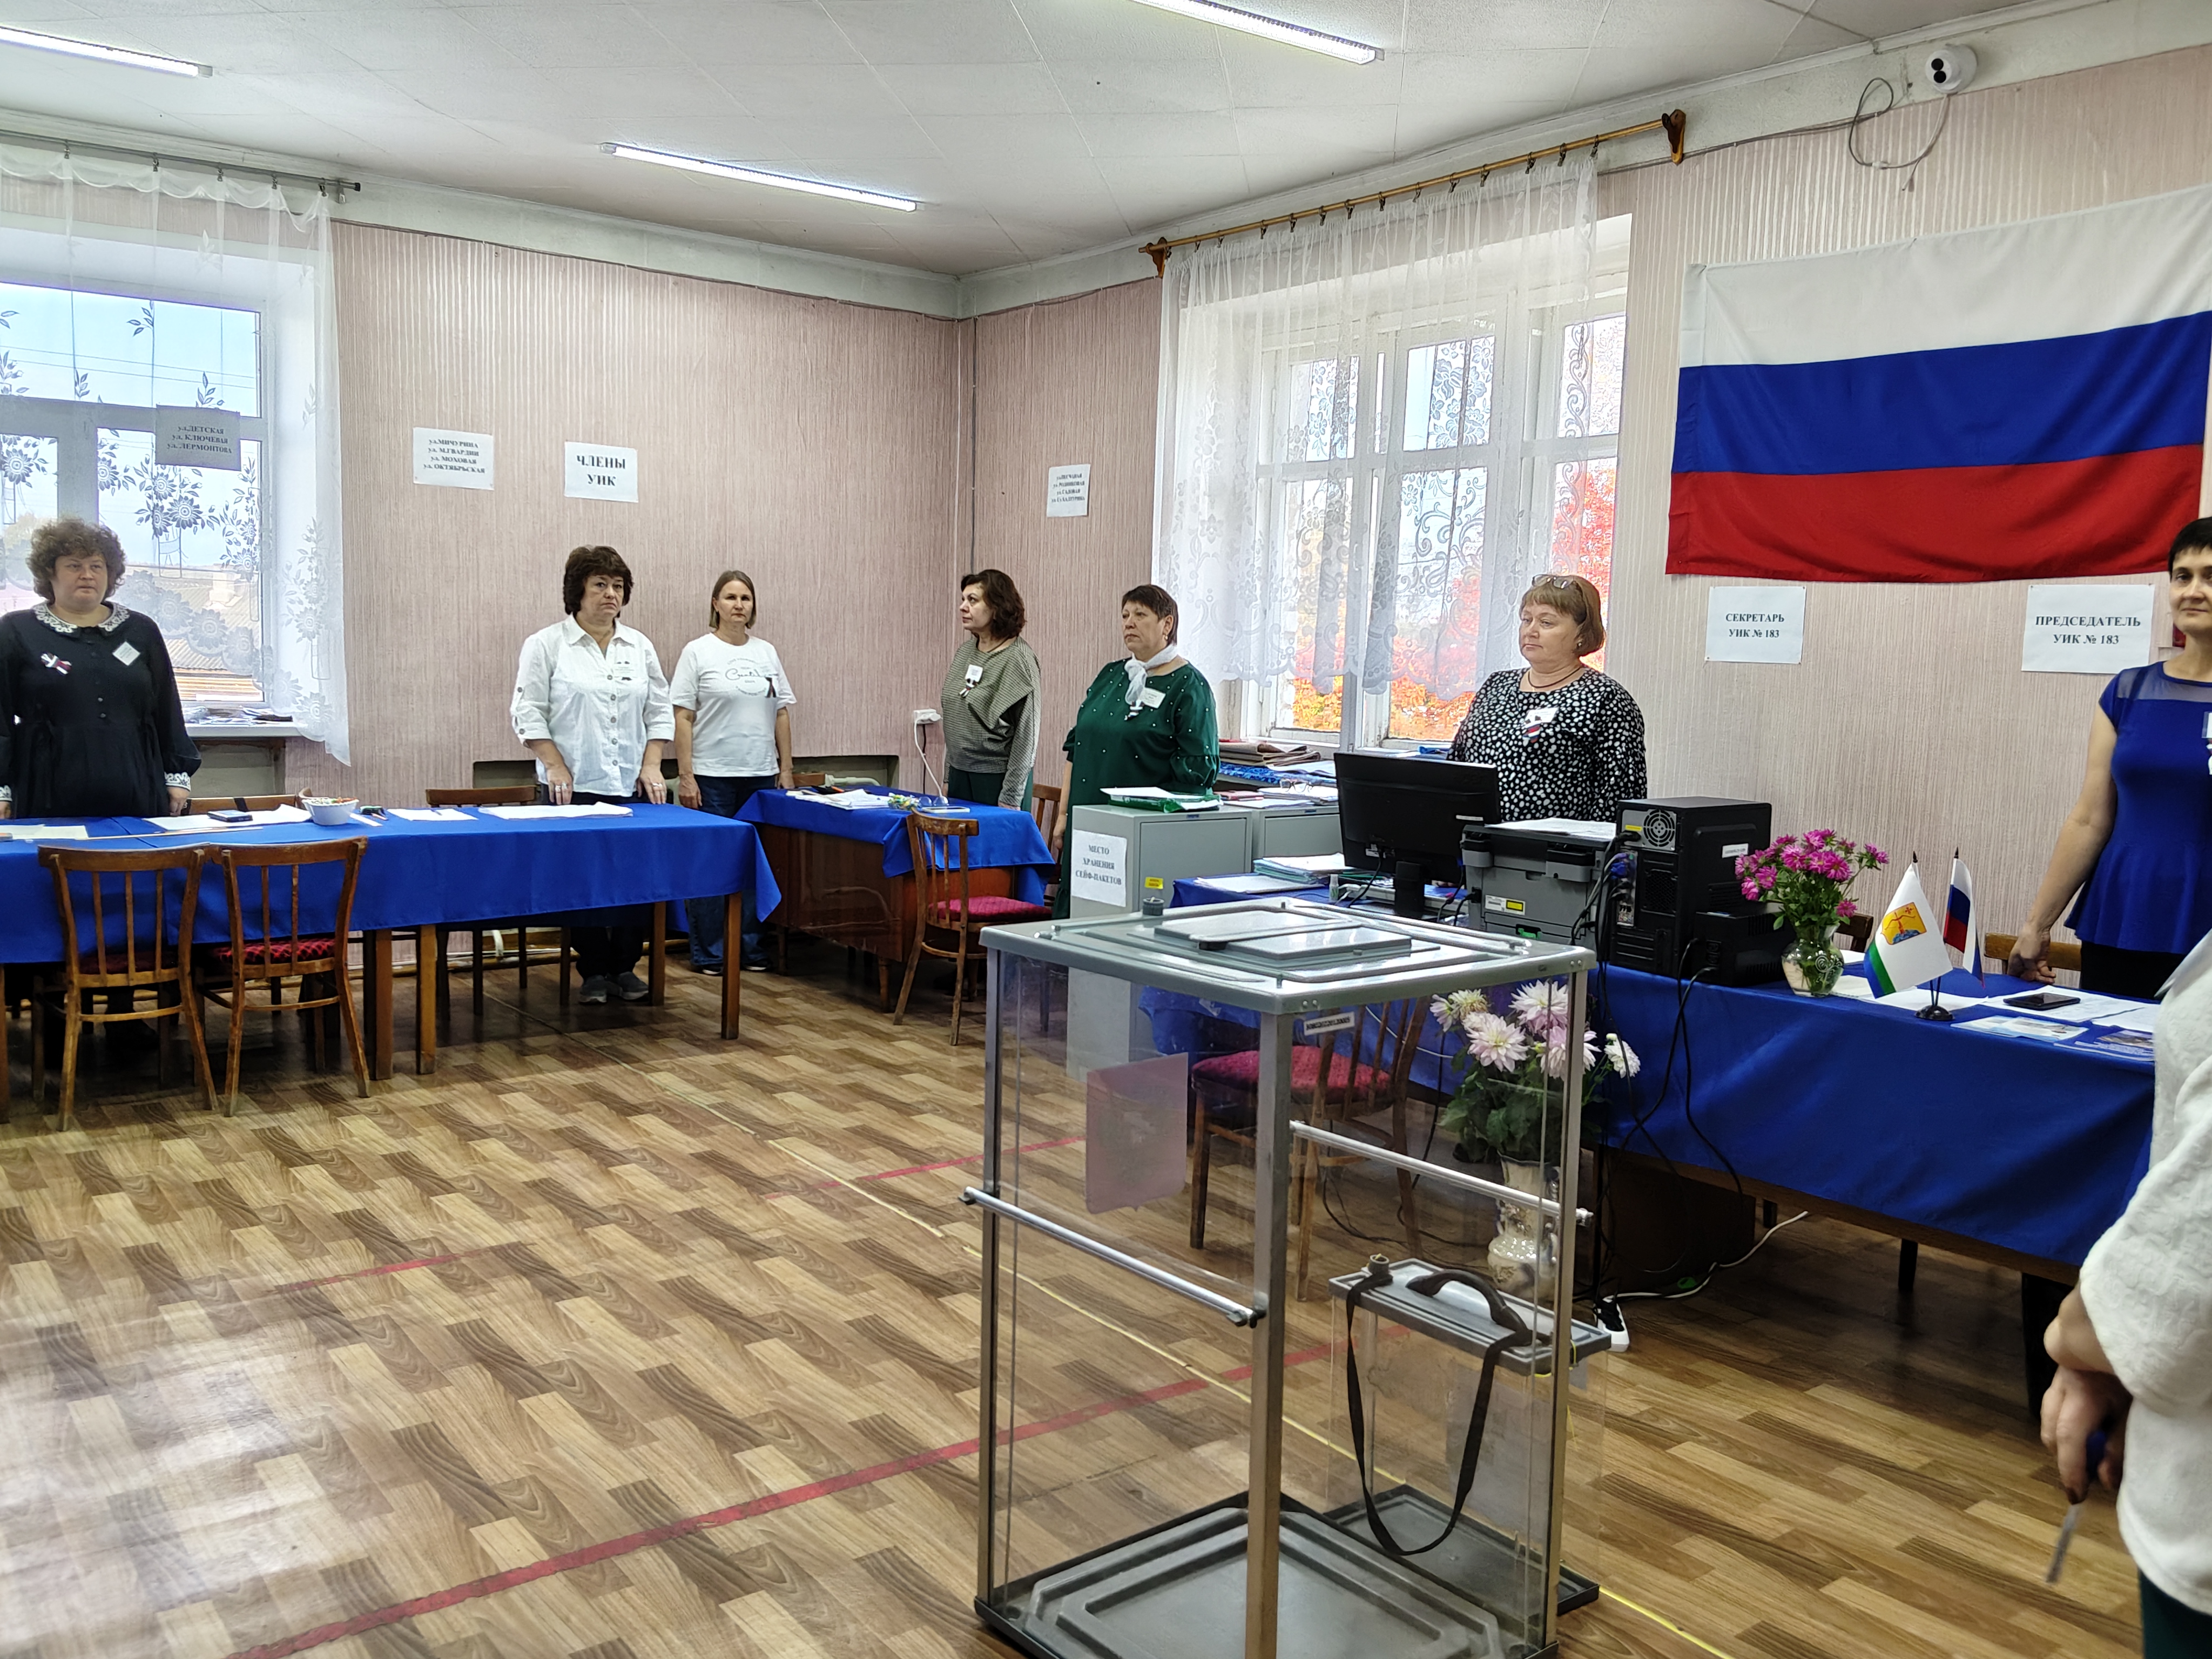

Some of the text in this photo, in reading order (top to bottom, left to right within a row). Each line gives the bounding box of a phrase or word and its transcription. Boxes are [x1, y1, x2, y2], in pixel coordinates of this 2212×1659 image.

[177, 426, 224, 435] ул.ДЕТСКАЯ
[185, 434, 228, 444] КЛЮЧЕВАЯ
[179, 443, 232, 454] ЛЕРМОНТОВА
[441, 456, 476, 464] МОХОВАЯ
[577, 455, 626, 470] ЧЛЕНЫ
[434, 464, 485, 473] ОКТЯБРЬСКАЯ
[588, 474, 616, 487] УИК
[1725, 613, 1785, 622] СЕКРЕТАРЬ
[2035, 616, 2141, 627] ПРЕДСЕДАТЕЛЬ
[1729, 629, 1779, 638] УИК № 183
[2053, 634, 2119, 644] УИК № 183
[1088, 845, 1110, 855] МЕСТО
[1082, 857, 1115, 870] ХРАНЕНИЯ
